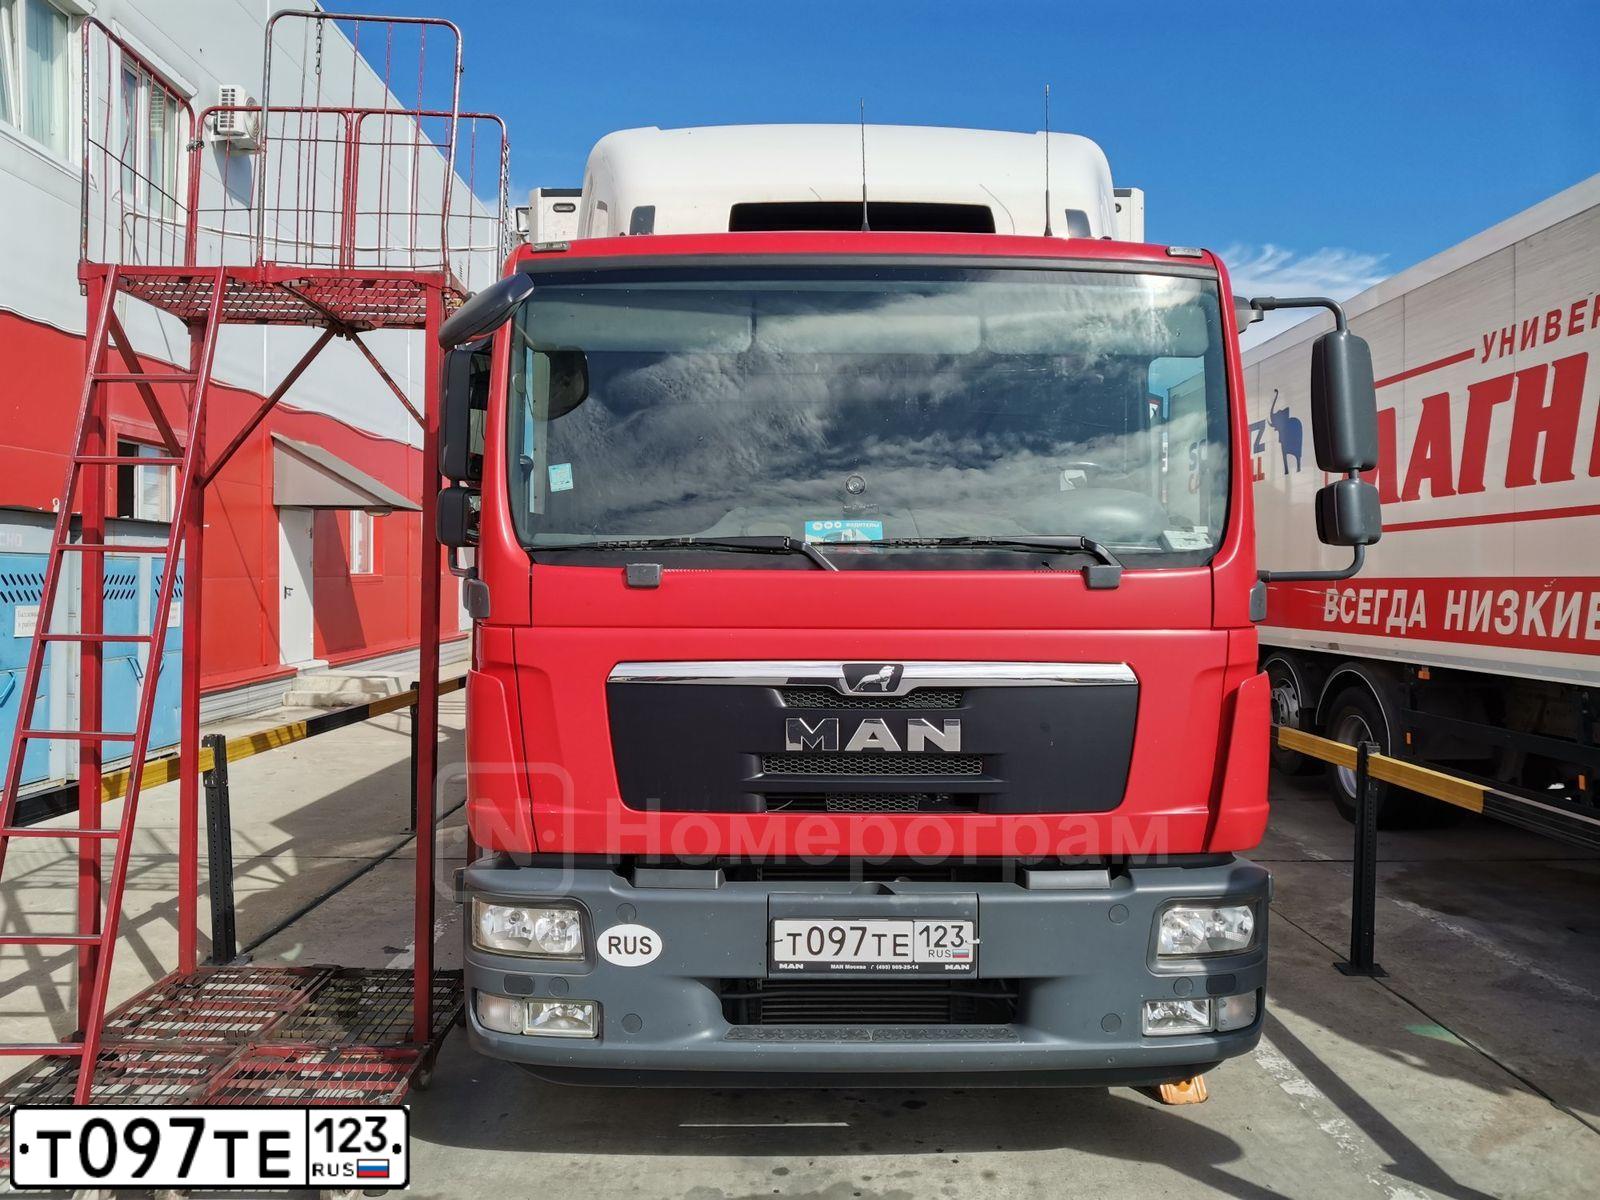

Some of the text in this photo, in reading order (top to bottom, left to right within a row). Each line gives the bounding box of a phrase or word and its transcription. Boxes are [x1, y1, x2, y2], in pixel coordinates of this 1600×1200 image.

[1326, 352, 1600, 505] АГН
[1324, 588, 1600, 641] ВСЕГДА НИЗКИЕ
[785, 717, 962, 753] MAN
[608, 935, 652, 955] RUS
[918, 925, 964, 948] 123
[928, 949, 951, 958] RUS
